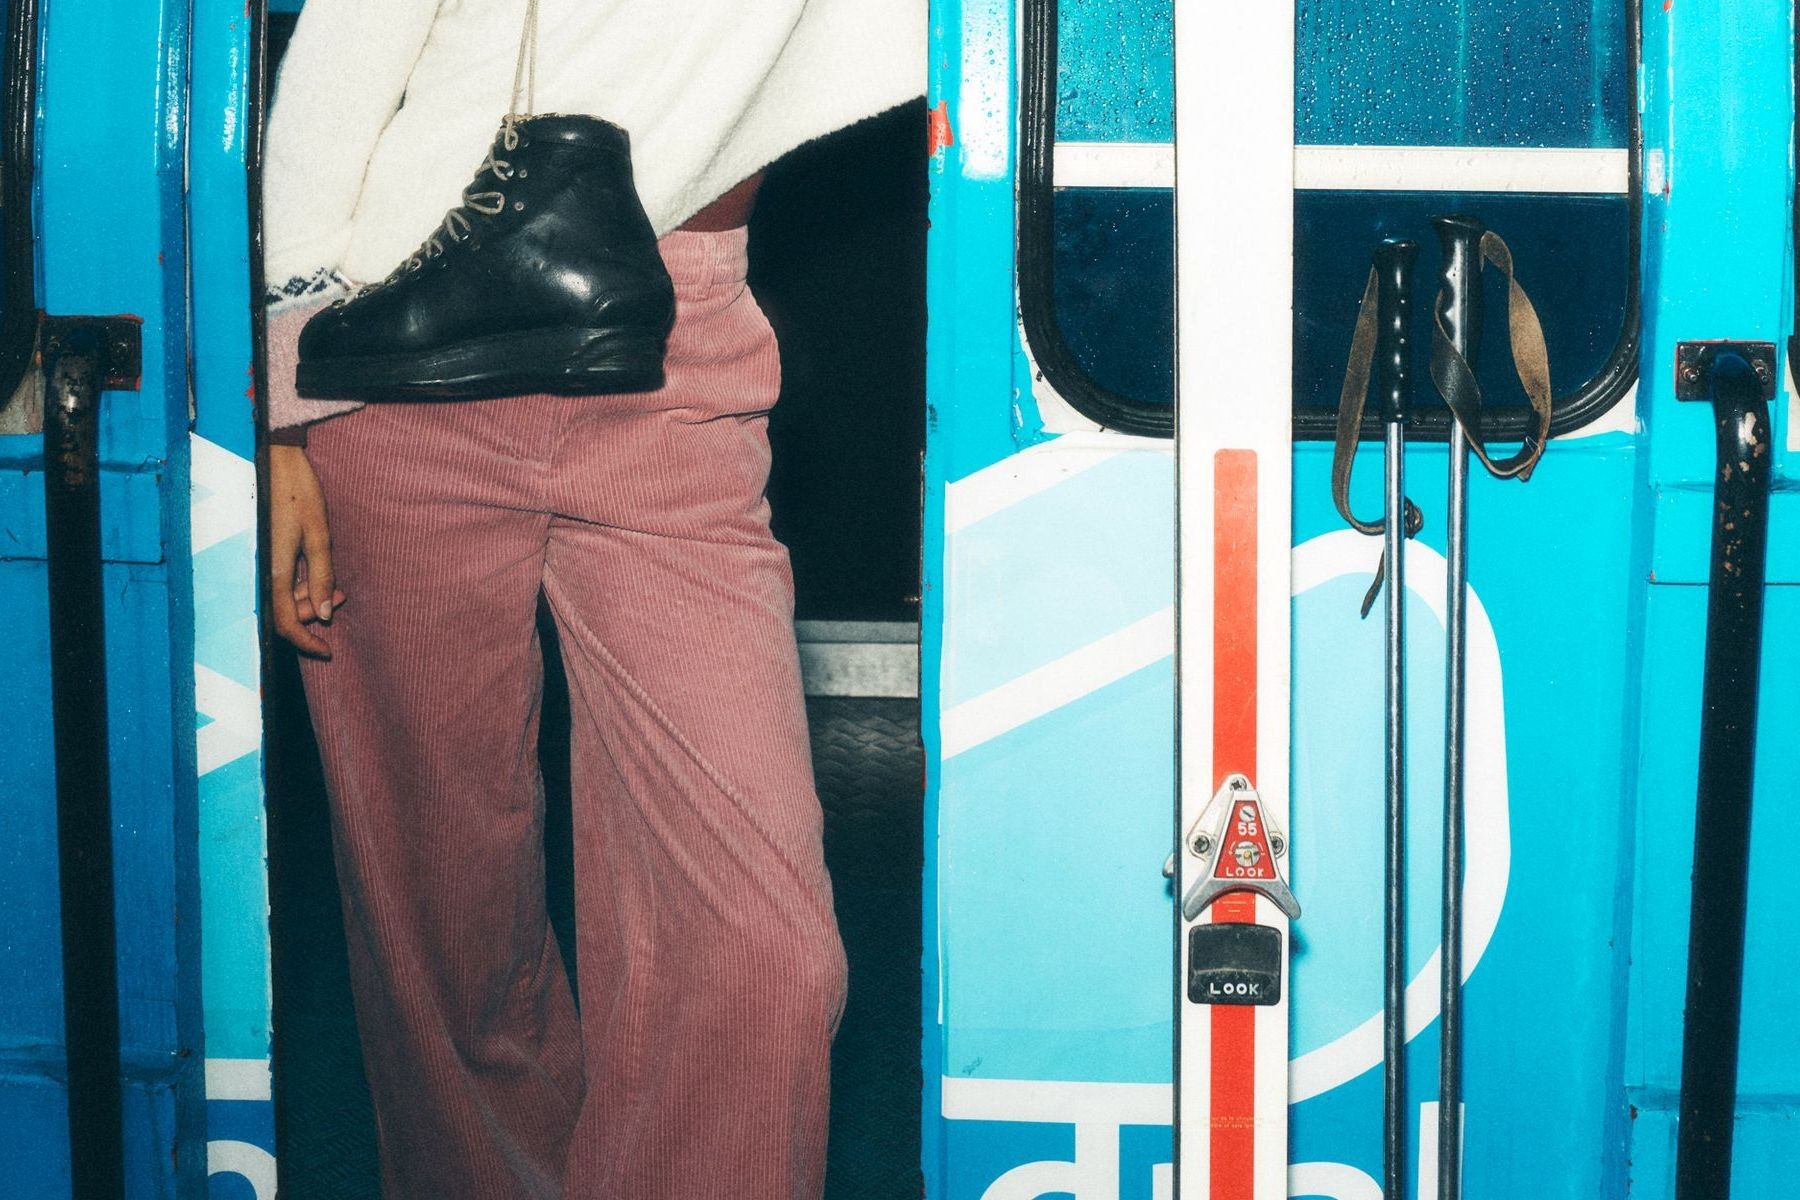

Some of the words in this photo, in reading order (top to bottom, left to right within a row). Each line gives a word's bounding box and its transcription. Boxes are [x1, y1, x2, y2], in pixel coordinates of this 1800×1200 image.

[1237, 821, 1258, 837] 55
[1225, 866, 1265, 877] LOOK
[1209, 982, 1260, 996] LOOK
